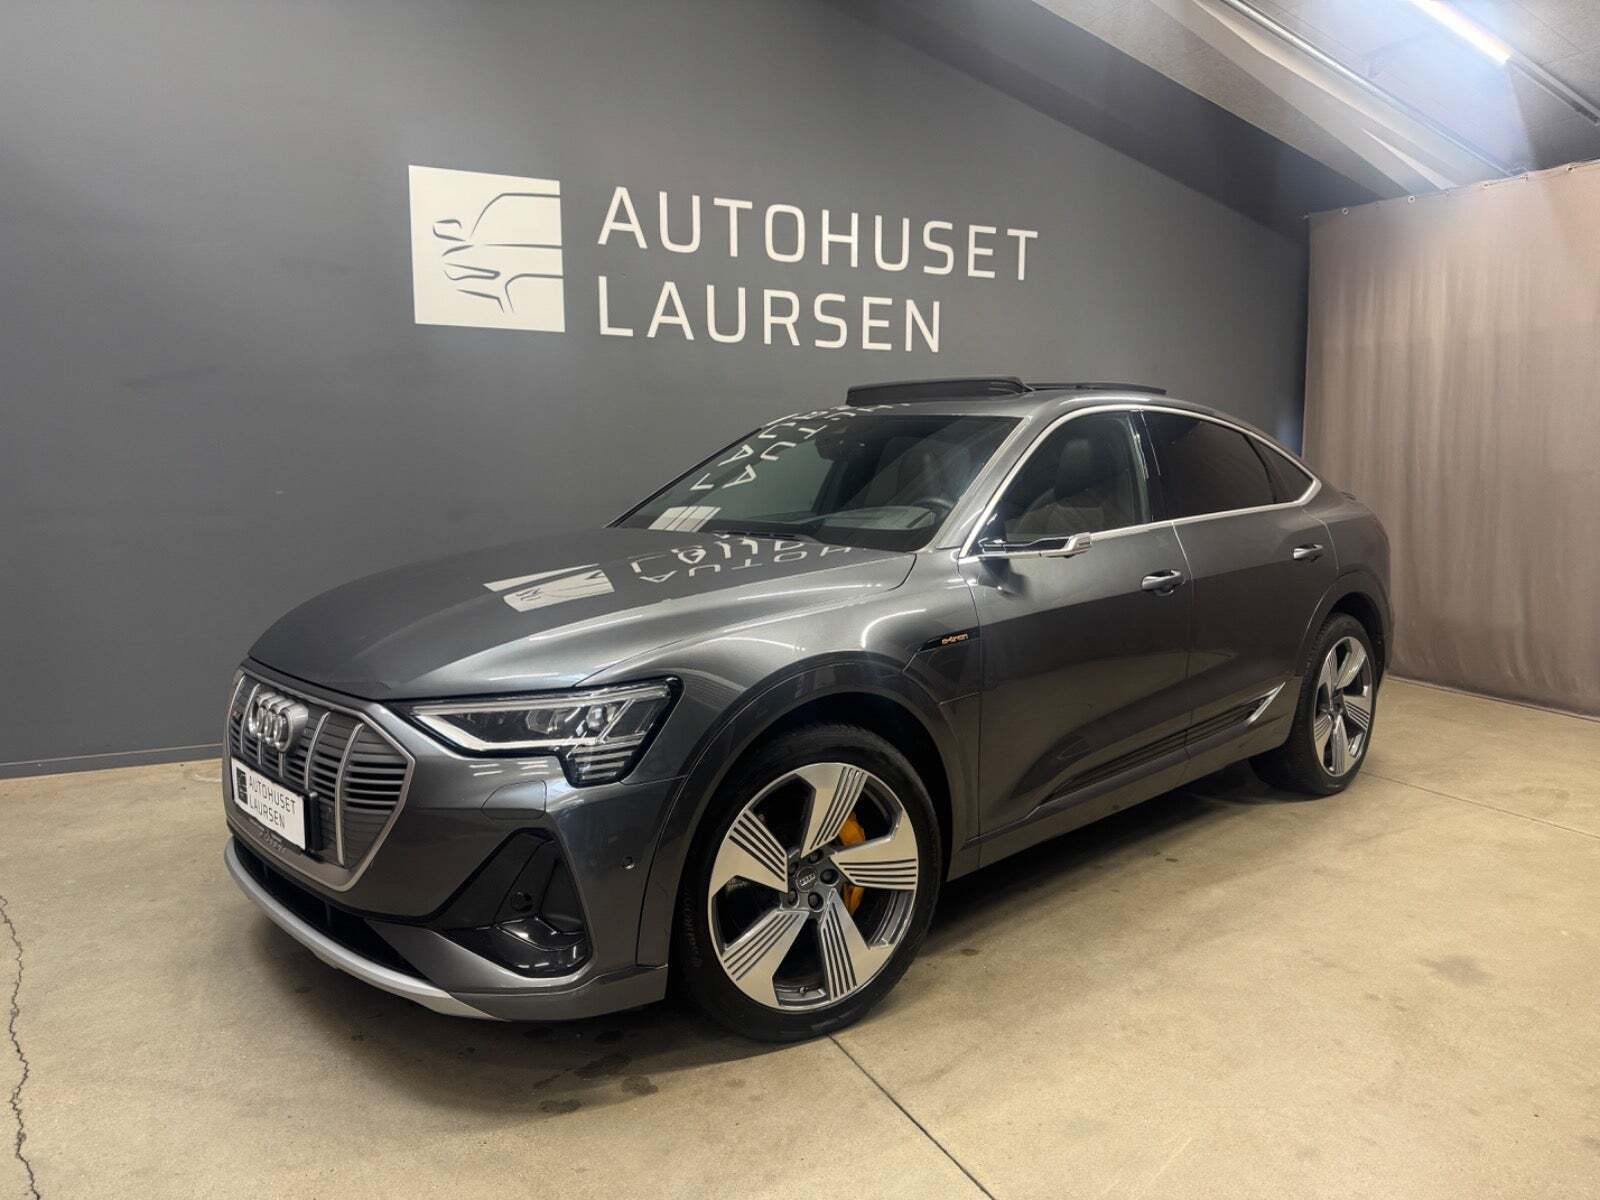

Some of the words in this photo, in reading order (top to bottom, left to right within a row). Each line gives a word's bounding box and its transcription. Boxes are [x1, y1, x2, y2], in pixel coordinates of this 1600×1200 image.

[597, 185, 1039, 281] AUTOHUSET
[597, 275, 941, 353] LAURSEN
[249, 775, 296, 815] AUTOHUSET
[249, 793, 286, 829] LAURSEN
